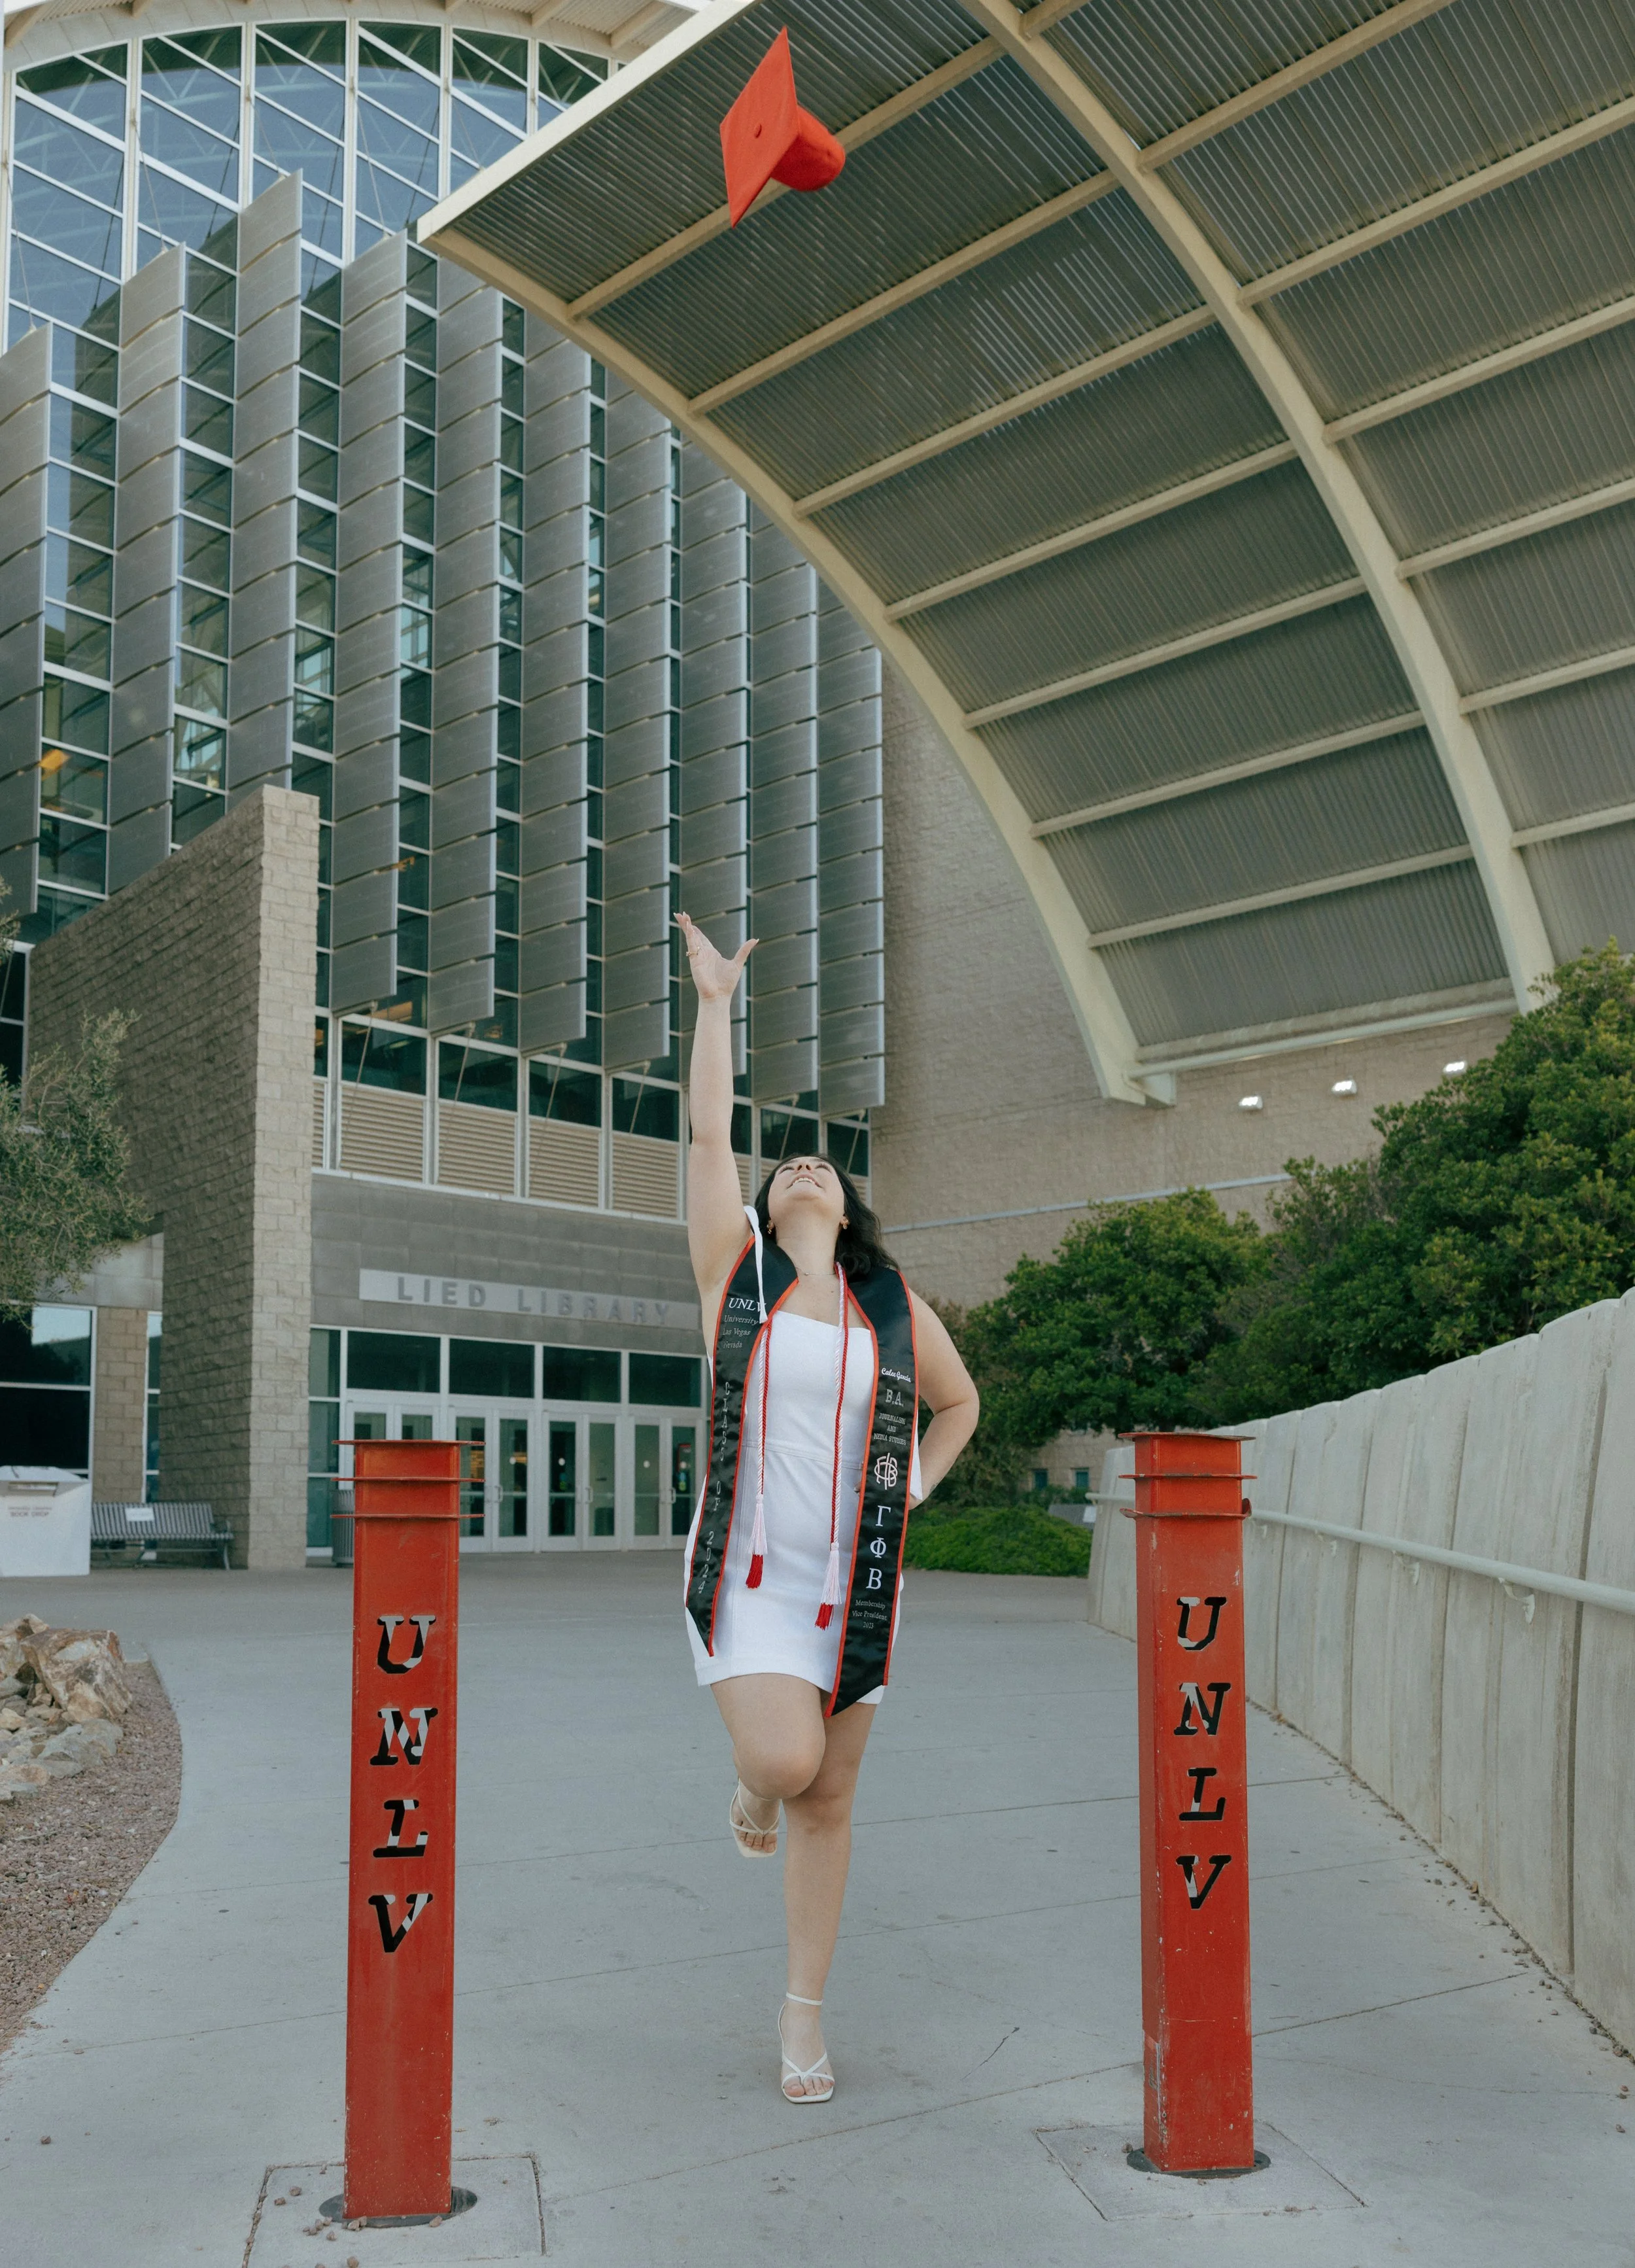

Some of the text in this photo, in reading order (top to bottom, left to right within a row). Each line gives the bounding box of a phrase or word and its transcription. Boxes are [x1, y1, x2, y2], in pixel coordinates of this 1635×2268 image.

[398, 1276, 668, 1325] LIED LIBRARY
[724, 1315, 759, 1325] University
[734, 1328, 751, 1336] Vegas
[897, 1371, 911, 1382] Garcia
[886, 1389, 904, 1407] B.A.
[879, 1413, 905, 1425] JOURNALISM
[889, 1436, 906, 1446] STUDIES
[698, 1531, 714, 1594] 2024
[855, 1599, 886, 1611] Membership
[863, 1611, 887, 1621] President
[1174, 1596, 1231, 1910] UNLV
[368, 1614, 438, 1953] UNLV
